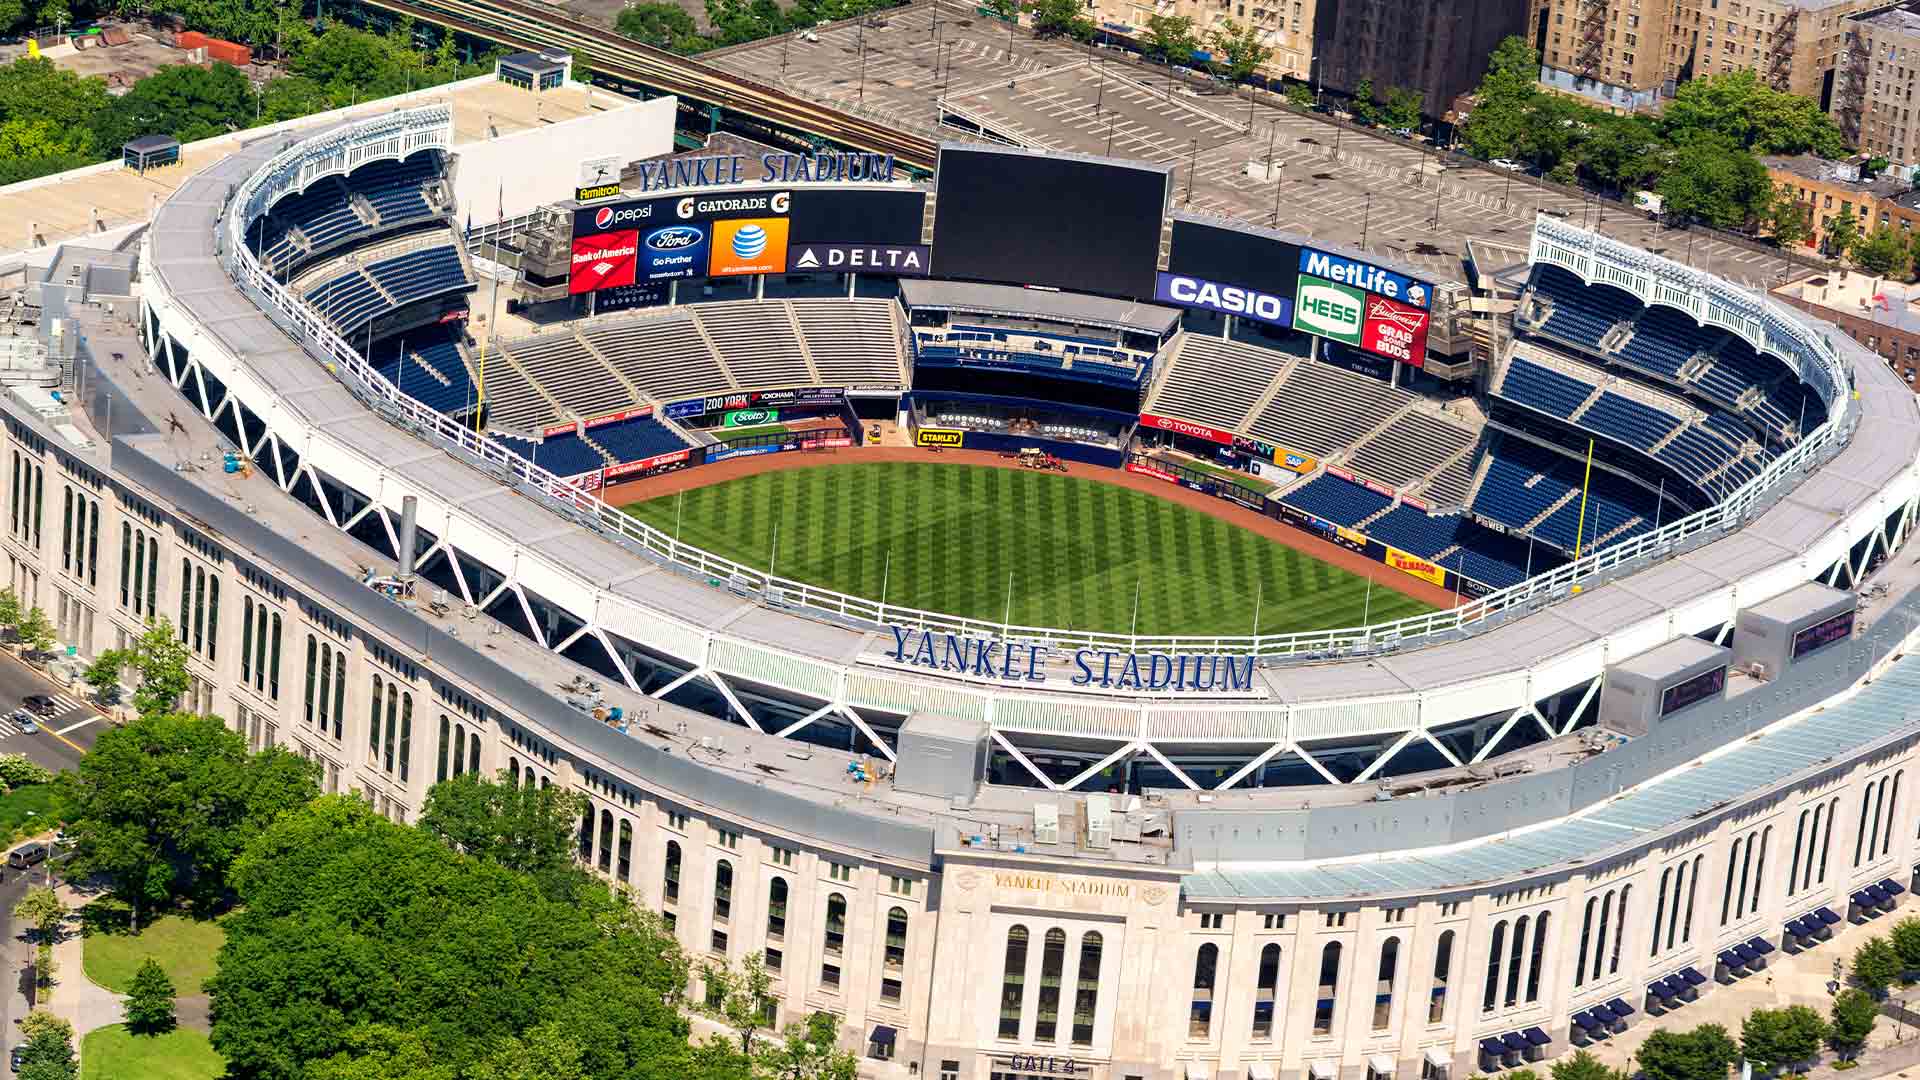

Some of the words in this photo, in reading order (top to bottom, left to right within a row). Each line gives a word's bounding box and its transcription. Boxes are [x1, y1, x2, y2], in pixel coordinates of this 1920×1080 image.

[640, 156, 745, 192] YANKEE
[762, 152, 896, 183] STADIUM
[580, 184, 620, 200] Armitron
[615, 204, 652, 223] pepsi
[698, 198, 767, 213] GATORADE
[656, 230, 692, 247] Ford
[573, 251, 592, 263] Bank
[593, 250, 601, 260] of
[602, 246, 635, 259] America
[653, 258, 665, 266] Go
[665, 255, 692, 265] Further
[829, 248, 920, 268] DELTA
[1307, 252, 1398, 297] MetLife
[1170, 277, 1281, 320] CASIO
[1303, 295, 1357, 324] HESS
[1370, 302, 1423, 327] Budweiser
[1378, 323, 1413, 343] GRAB
[1384, 335, 1407, 348] SOME
[1376, 340, 1411, 360] BUDS
[706, 397, 723, 410] ZOO
[724, 394, 748, 409] YORK
[761, 391, 794, 400] YOKOHAMA
[737, 410, 765, 422] Scotts
[922, 433, 960, 443] STANLEY
[1174, 421, 1213, 438] TOYOTA
[1285, 455, 1302, 468] SAP
[1466, 580, 1492, 595] SONY
[888, 626, 1049, 681] YANKEE
[1072, 650, 1256, 690] STADIUM
[994, 873, 1052, 892] YANKEE
[1061, 879, 1130, 897] STADIUM
[1011, 1054, 1057, 1074] GATE
[1064, 1058, 1076, 1074] 4
